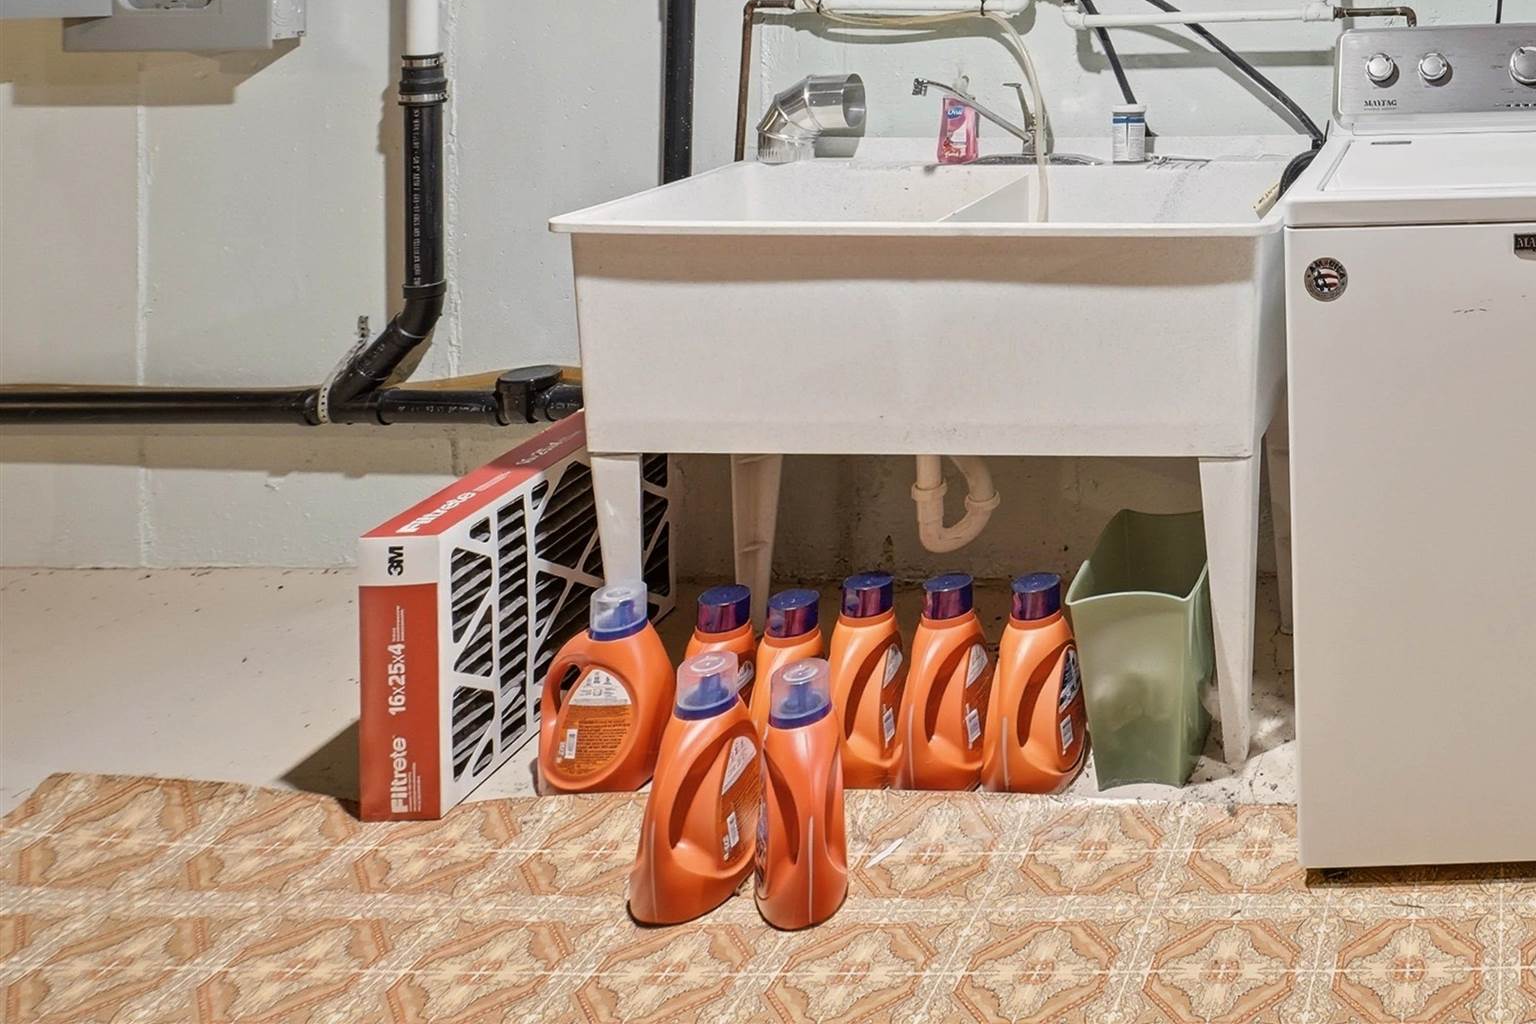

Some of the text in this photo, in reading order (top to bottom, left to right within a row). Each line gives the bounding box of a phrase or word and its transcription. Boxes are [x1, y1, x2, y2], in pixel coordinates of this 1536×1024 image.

[395, 490, 476, 534] Filtrete
[387, 545, 404, 576] 3M
[387, 642, 407, 716] 16x25x4
[390, 736, 409, 814] Filtrete
